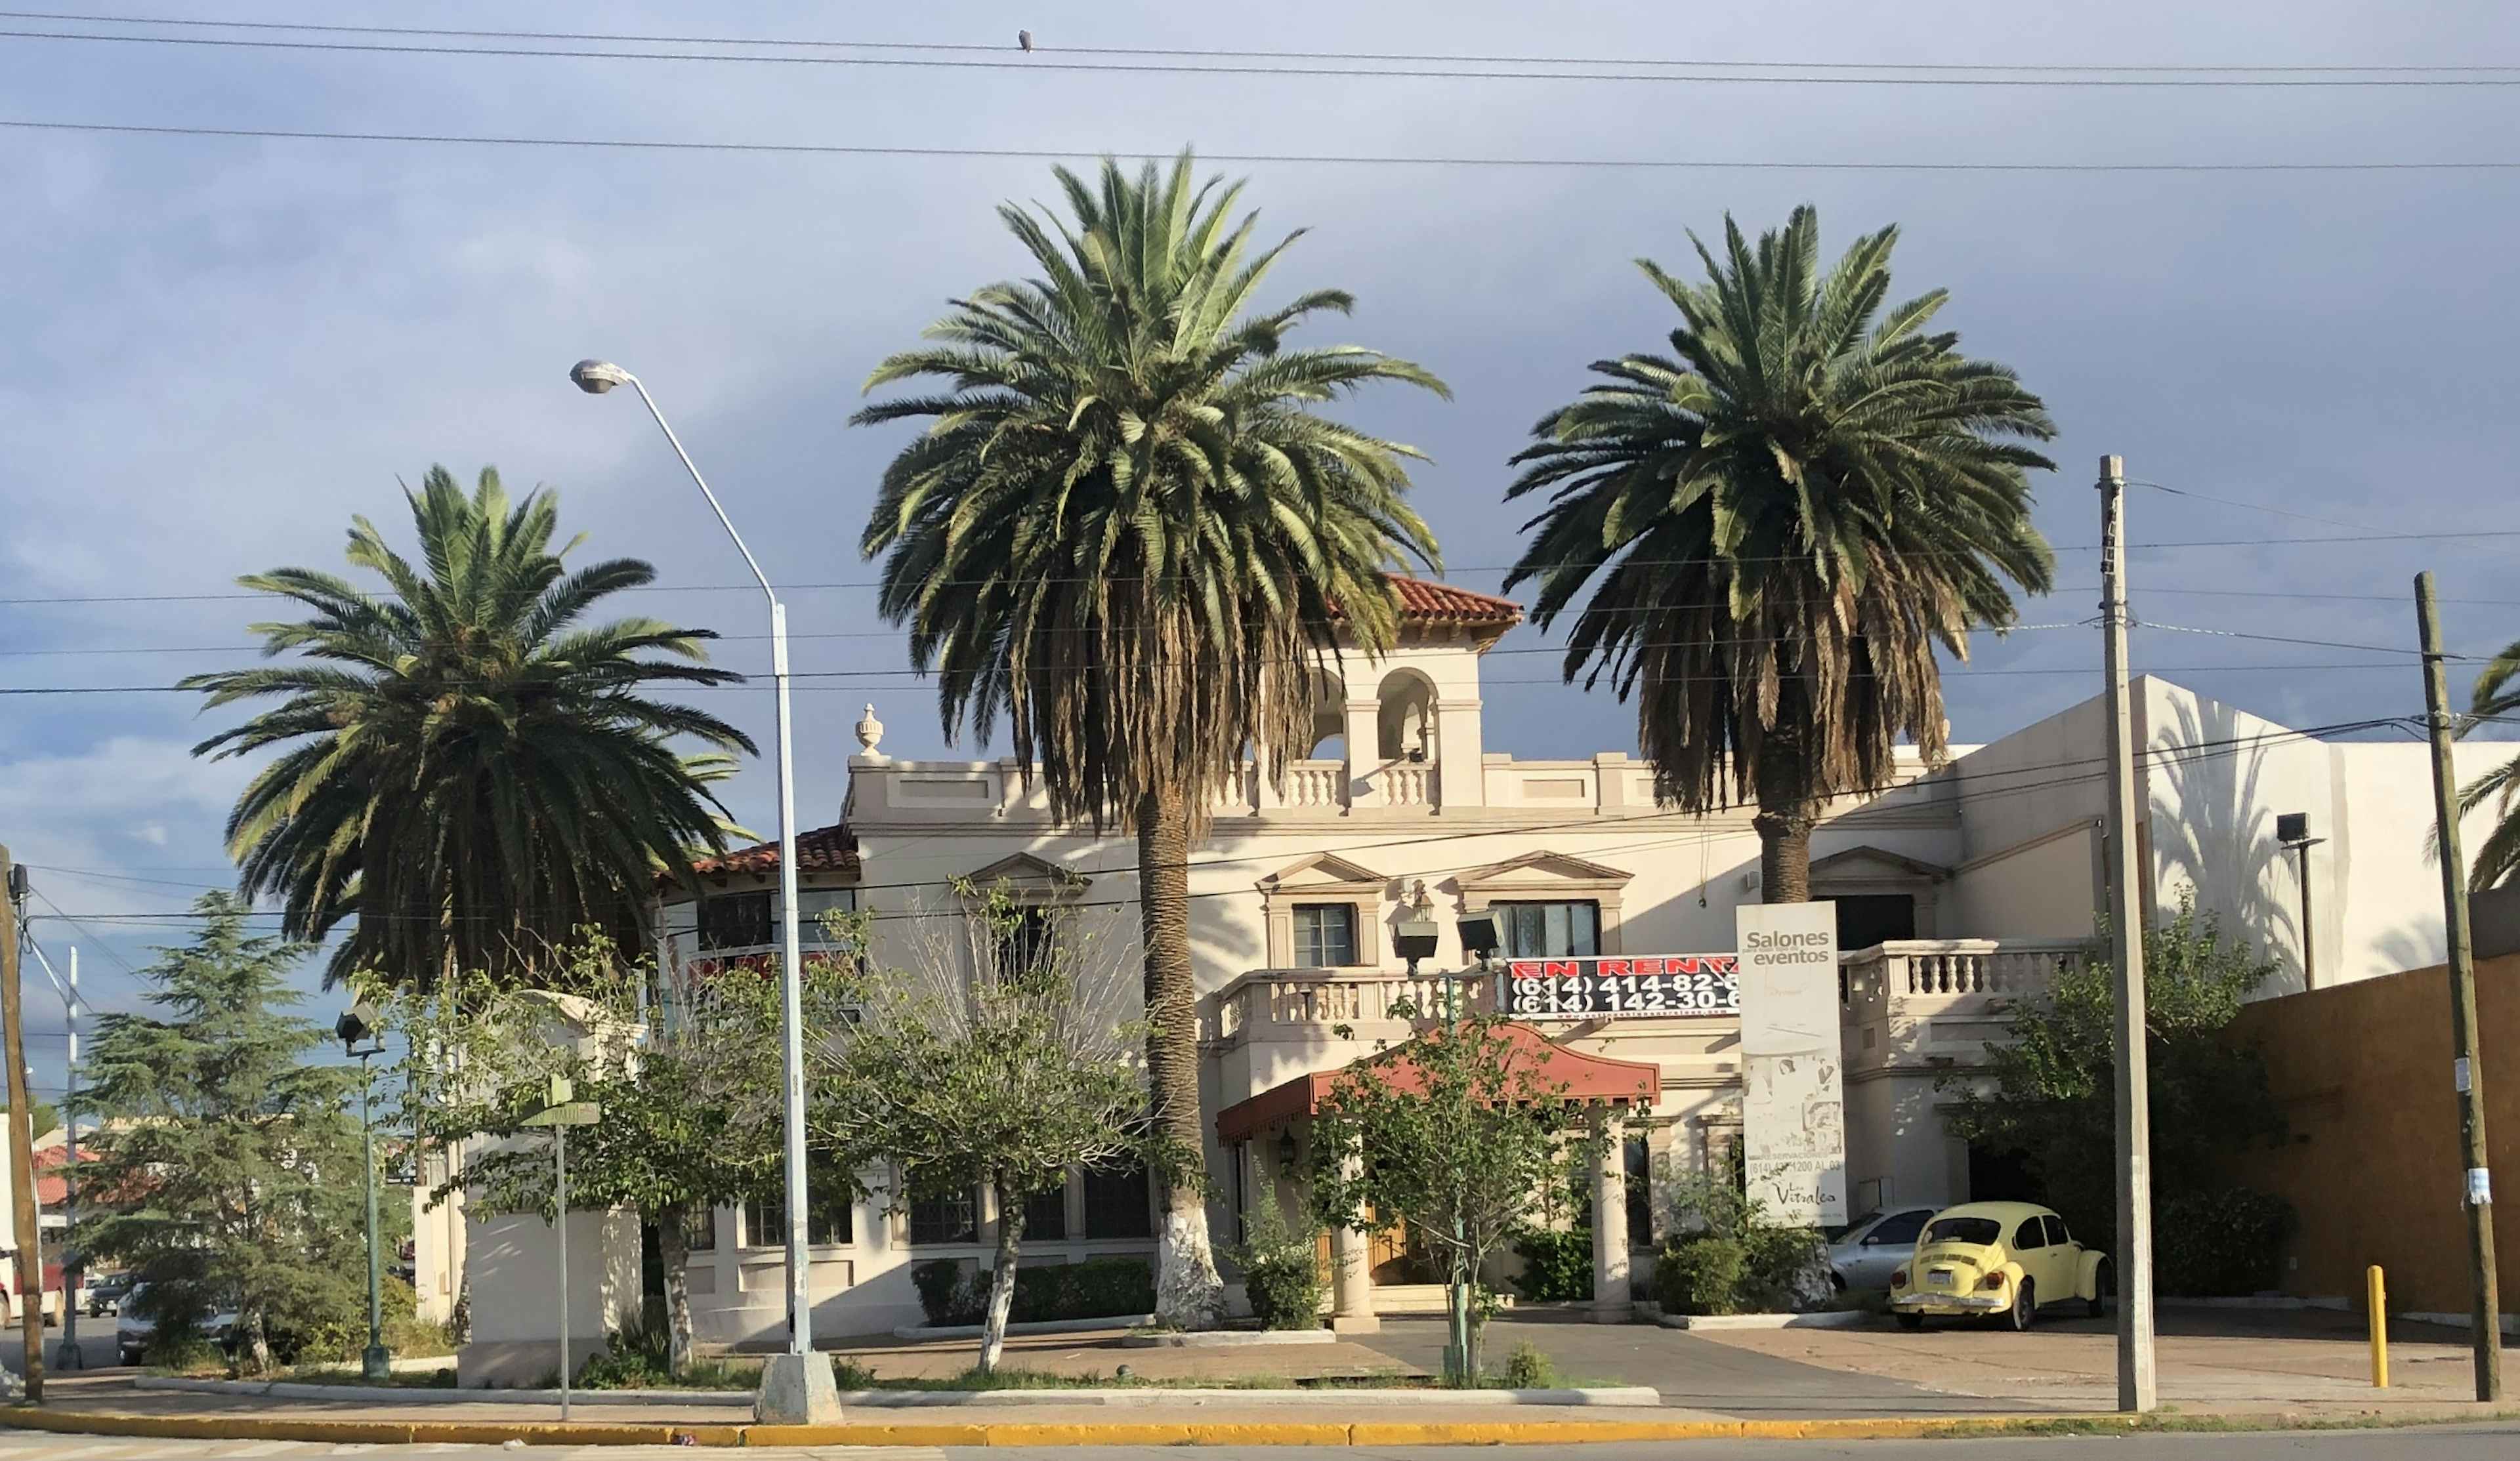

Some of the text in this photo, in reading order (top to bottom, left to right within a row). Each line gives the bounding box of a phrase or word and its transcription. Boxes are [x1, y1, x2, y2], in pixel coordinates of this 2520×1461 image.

[1747, 931, 1829, 948] Salones
[1754, 950, 1829, 965] eventos
[1511, 962, 1580, 977] EN
[1512, 976, 1592, 996] (614)
[1513, 995, 1593, 1013] (614)
